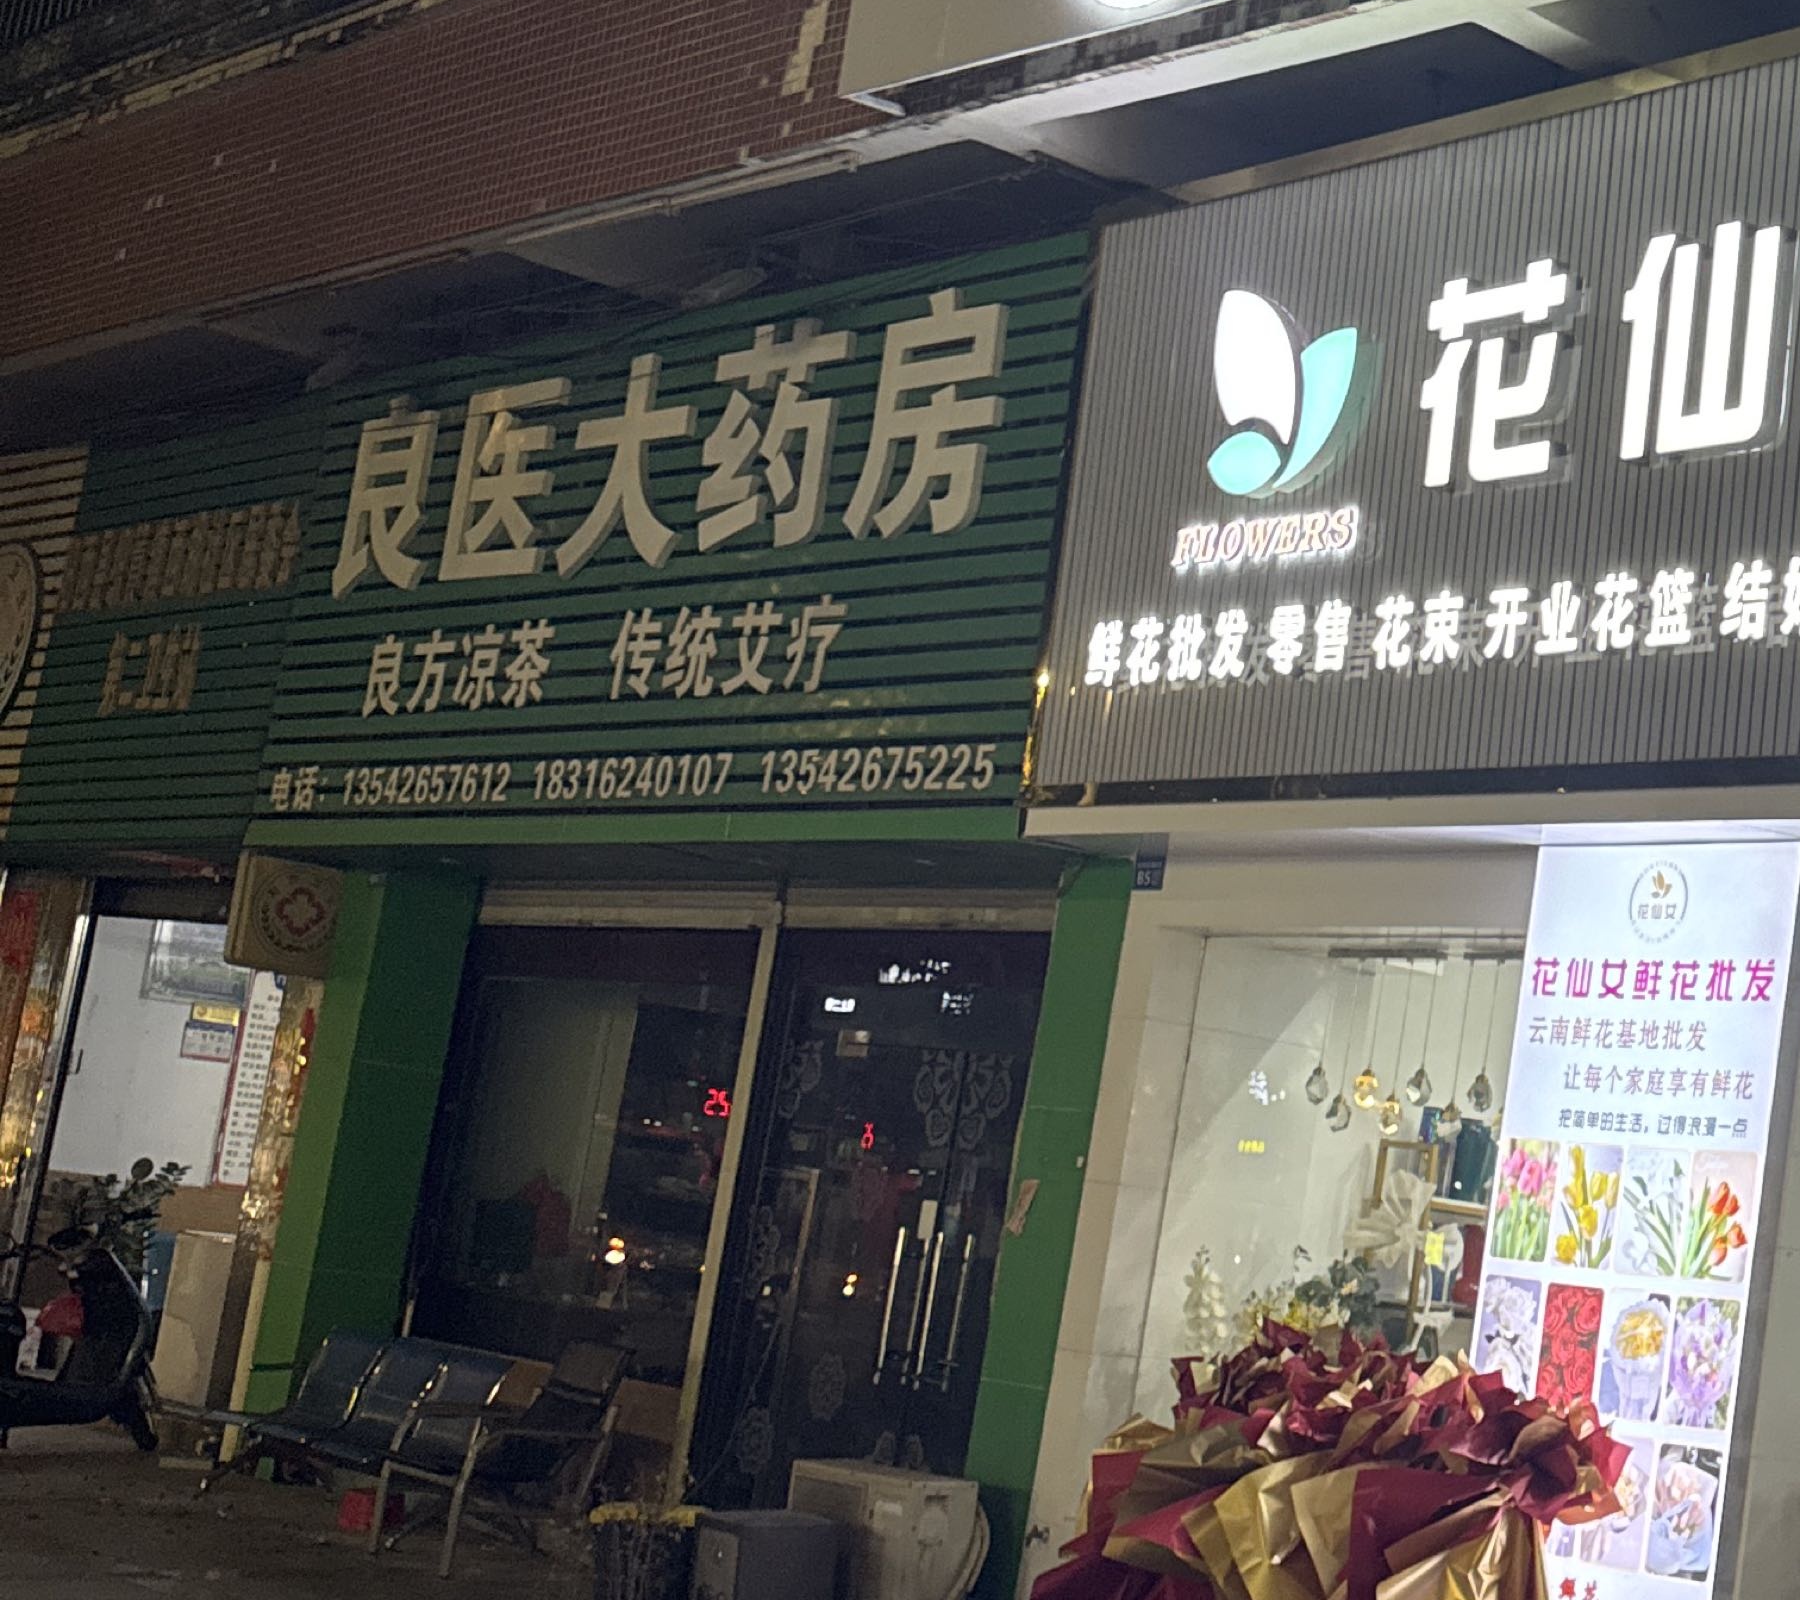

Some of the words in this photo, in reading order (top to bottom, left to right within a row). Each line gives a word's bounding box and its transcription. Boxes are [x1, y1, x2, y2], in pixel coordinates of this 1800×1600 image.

[332, 286, 1008, 598] 良医大药房
[1171, 505, 1360, 572] FLOWERS
[361, 618, 556, 719] 良方凉茶
[609, 594, 849, 700] 传统艾疗
[1085, 609, 1248, 686] 鲜花批发
[1266, 599, 1352, 674] 零售
[1372, 589, 1464, 671] 花束
[1483, 568, 1695, 658] 开业花篮
[341, 761, 512, 807] 13542657612
[533, 752, 734, 801] 18316240107
[760, 743, 997, 795] 13542675225
[1532, 957, 1776, 1002] 花仙女鲜花批发
[1528, 1015, 1708, 1052] 云南鲜花基地批发
[1563, 1062, 1755, 1100] 让每个家庭享有鲜花
